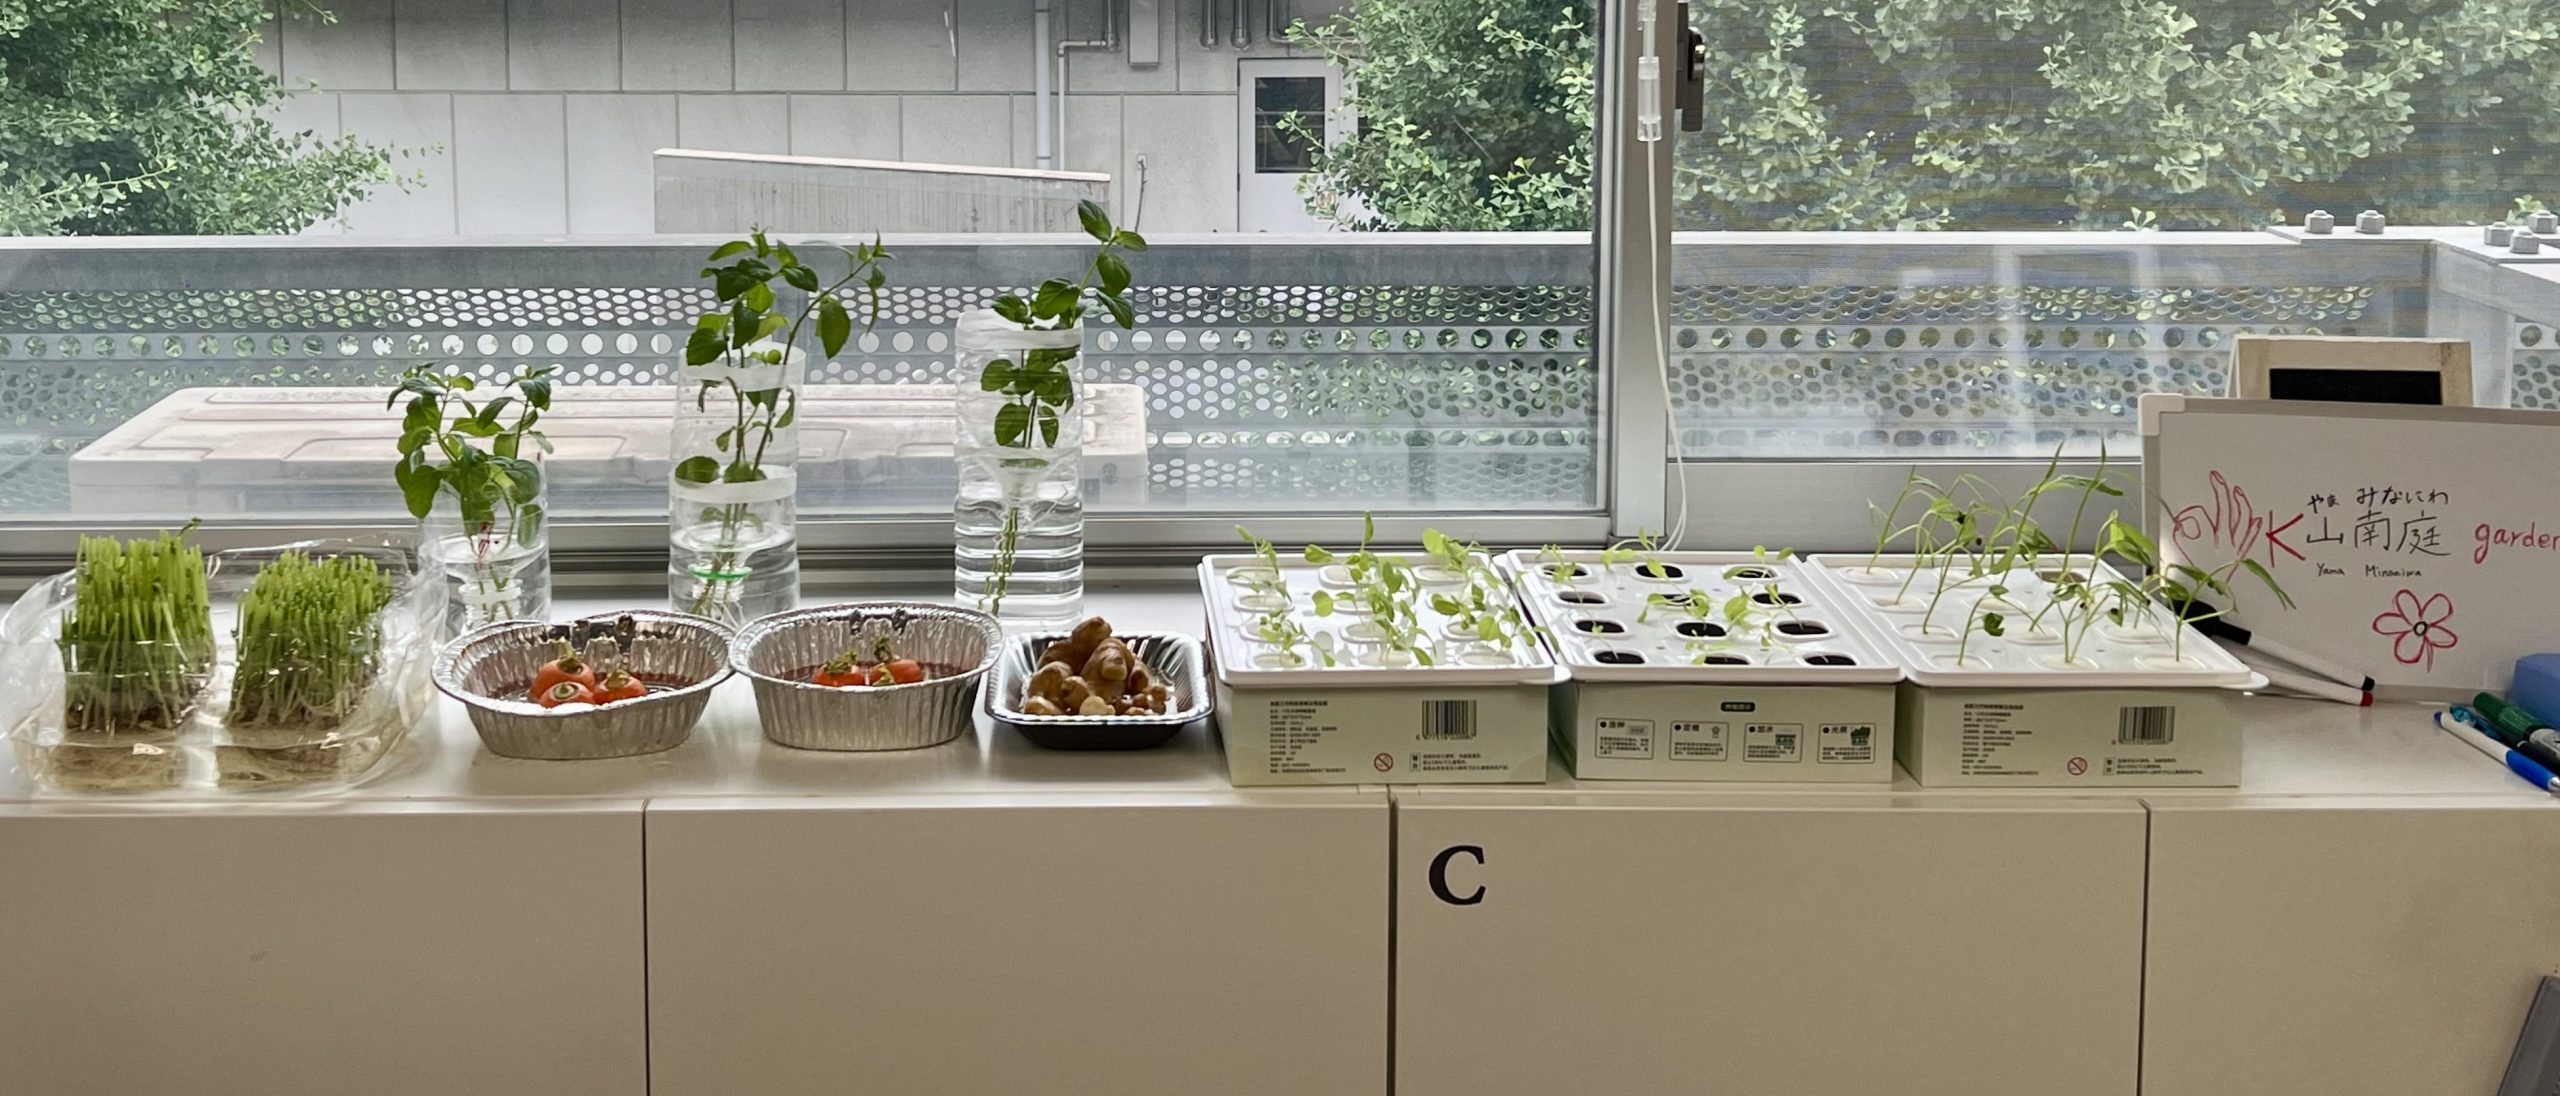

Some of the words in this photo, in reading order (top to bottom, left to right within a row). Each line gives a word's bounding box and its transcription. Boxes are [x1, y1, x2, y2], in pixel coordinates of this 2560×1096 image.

[2307, 493, 2340, 514] やま
[2356, 486, 2449, 507] みなにわ
[2265, 510, 2306, 568] K
[2306, 510, 2452, 556] 山南庭
[2316, 562, 2346, 577] Yama
[1428, 845, 1487, 906] C
